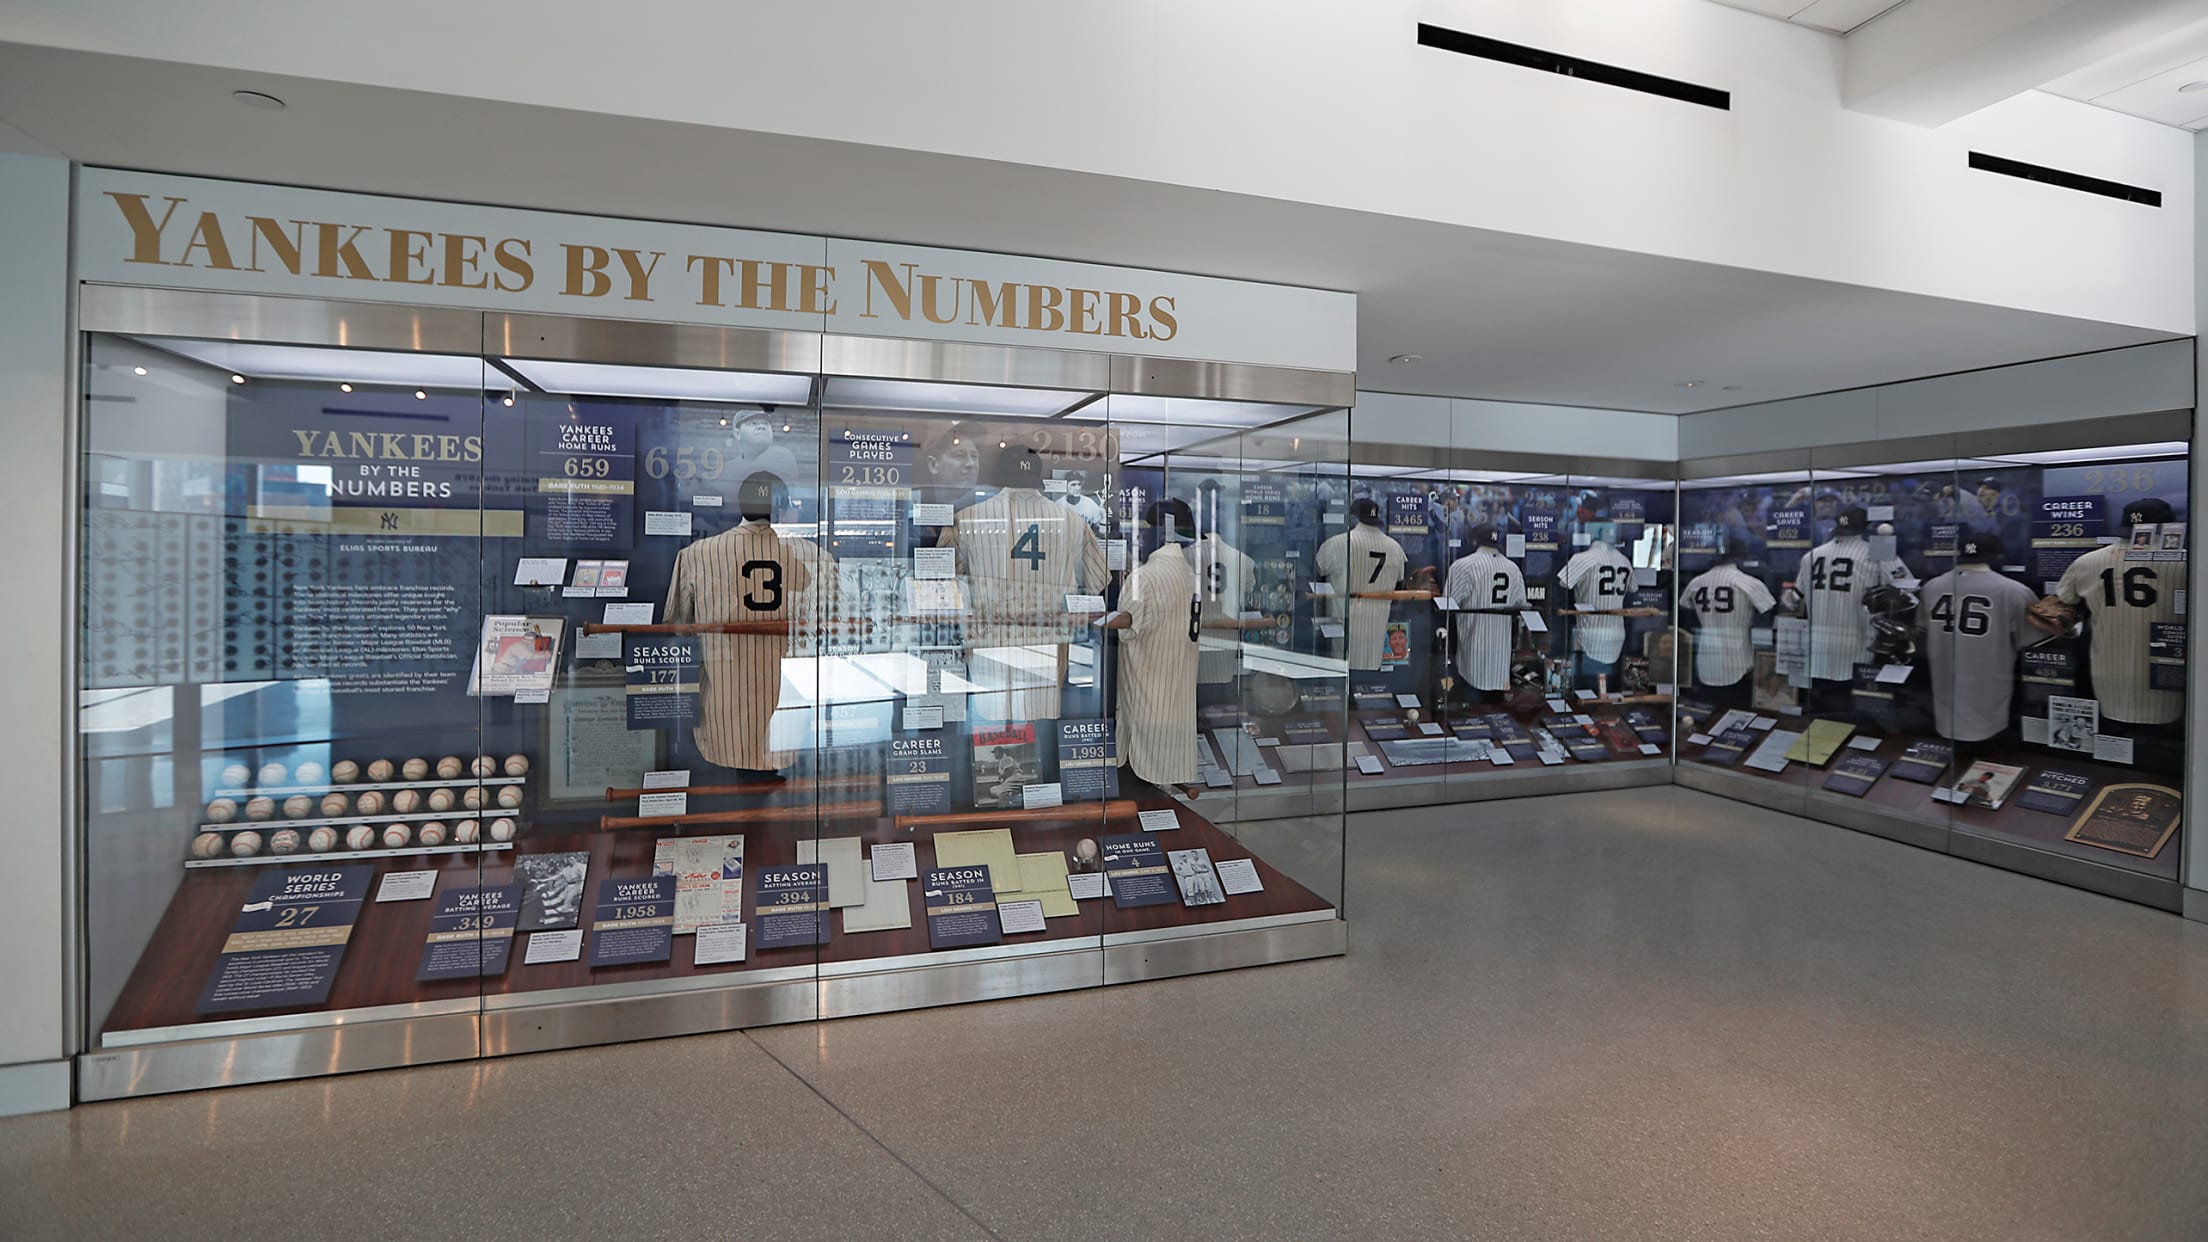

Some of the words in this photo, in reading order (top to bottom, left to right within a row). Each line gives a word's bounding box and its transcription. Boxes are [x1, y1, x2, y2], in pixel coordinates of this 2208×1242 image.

[103, 191, 535, 293] YANKEES
[559, 243, 665, 301] BY
[686, 255, 837, 315] THE
[859, 259, 1178, 342] NUMBERS
[559, 425, 613, 435] YANKEES
[562, 434, 609, 444] CAREER
[844, 434, 900, 442] CONSECUTIVE
[292, 430, 482, 462] YANKEES
[558, 442, 587, 450] HOME
[591, 444, 616, 452] RUNS
[852, 442, 891, 450] GAMES
[1033, 430, 1119, 464] 2,130
[850, 451, 893, 460] PLAYED
[564, 458, 610, 478] 659
[644, 446, 724, 480] 659
[360, 466, 380, 476] BY
[388, 466, 420, 478] THE
[842, 466, 900, 486] 2,130
[2086, 468, 2156, 493] 236
[330, 480, 451, 498] NUMBERS
[1119, 489, 1146, 497] ASON
[1258, 504, 1270, 515] 18
[2043, 502, 2093, 510] CAREER
[2052, 510, 2084, 519] WINS
[1532, 531, 1549, 542] 238
[1779, 528, 1799, 539] 652
[2050, 524, 2084, 537] 236
[340, 544, 364, 552] ELIAS
[368, 544, 400, 552] SPORTS
[1011, 524, 1046, 570] 4
[1368, 551, 1386, 584] 7
[1812, 556, 1853, 592] 42
[742, 560, 782, 610] 3
[1599, 565, 1630, 596] 23
[1492, 572, 1509, 604] 2
[2100, 566, 2157, 608] 16
[1695, 586, 1734, 613] 49
[1189, 593, 1201, 642] 8
[1931, 594, 1992, 636] 46
[634, 646, 691, 657] SEASON
[2025, 652, 2066, 660] CAREER
[659, 656, 692, 664] SCORED
[650, 670, 678, 683] 177
[1064, 724, 1108, 734] CAREER
[893, 740, 941, 750] CAREER
[1072, 747, 1105, 760] 1,993
[910, 761, 926, 773] 23
[2041, 773, 2086, 784] PITCHED
[1132, 857, 1140, 868] 4
[287, 873, 342, 883] WORLD
[765, 872, 820, 883] SEASON
[931, 870, 983, 881] SEASON
[284, 882, 336, 893] SERIES
[269, 891, 344, 901] CHAMPIONSHIPS
[776, 890, 810, 904] .394
[948, 892, 974, 904] 184
[274, 906, 320, 927] 27
[615, 905, 656, 920] 1,958
[452, 916, 495, 930] .349
